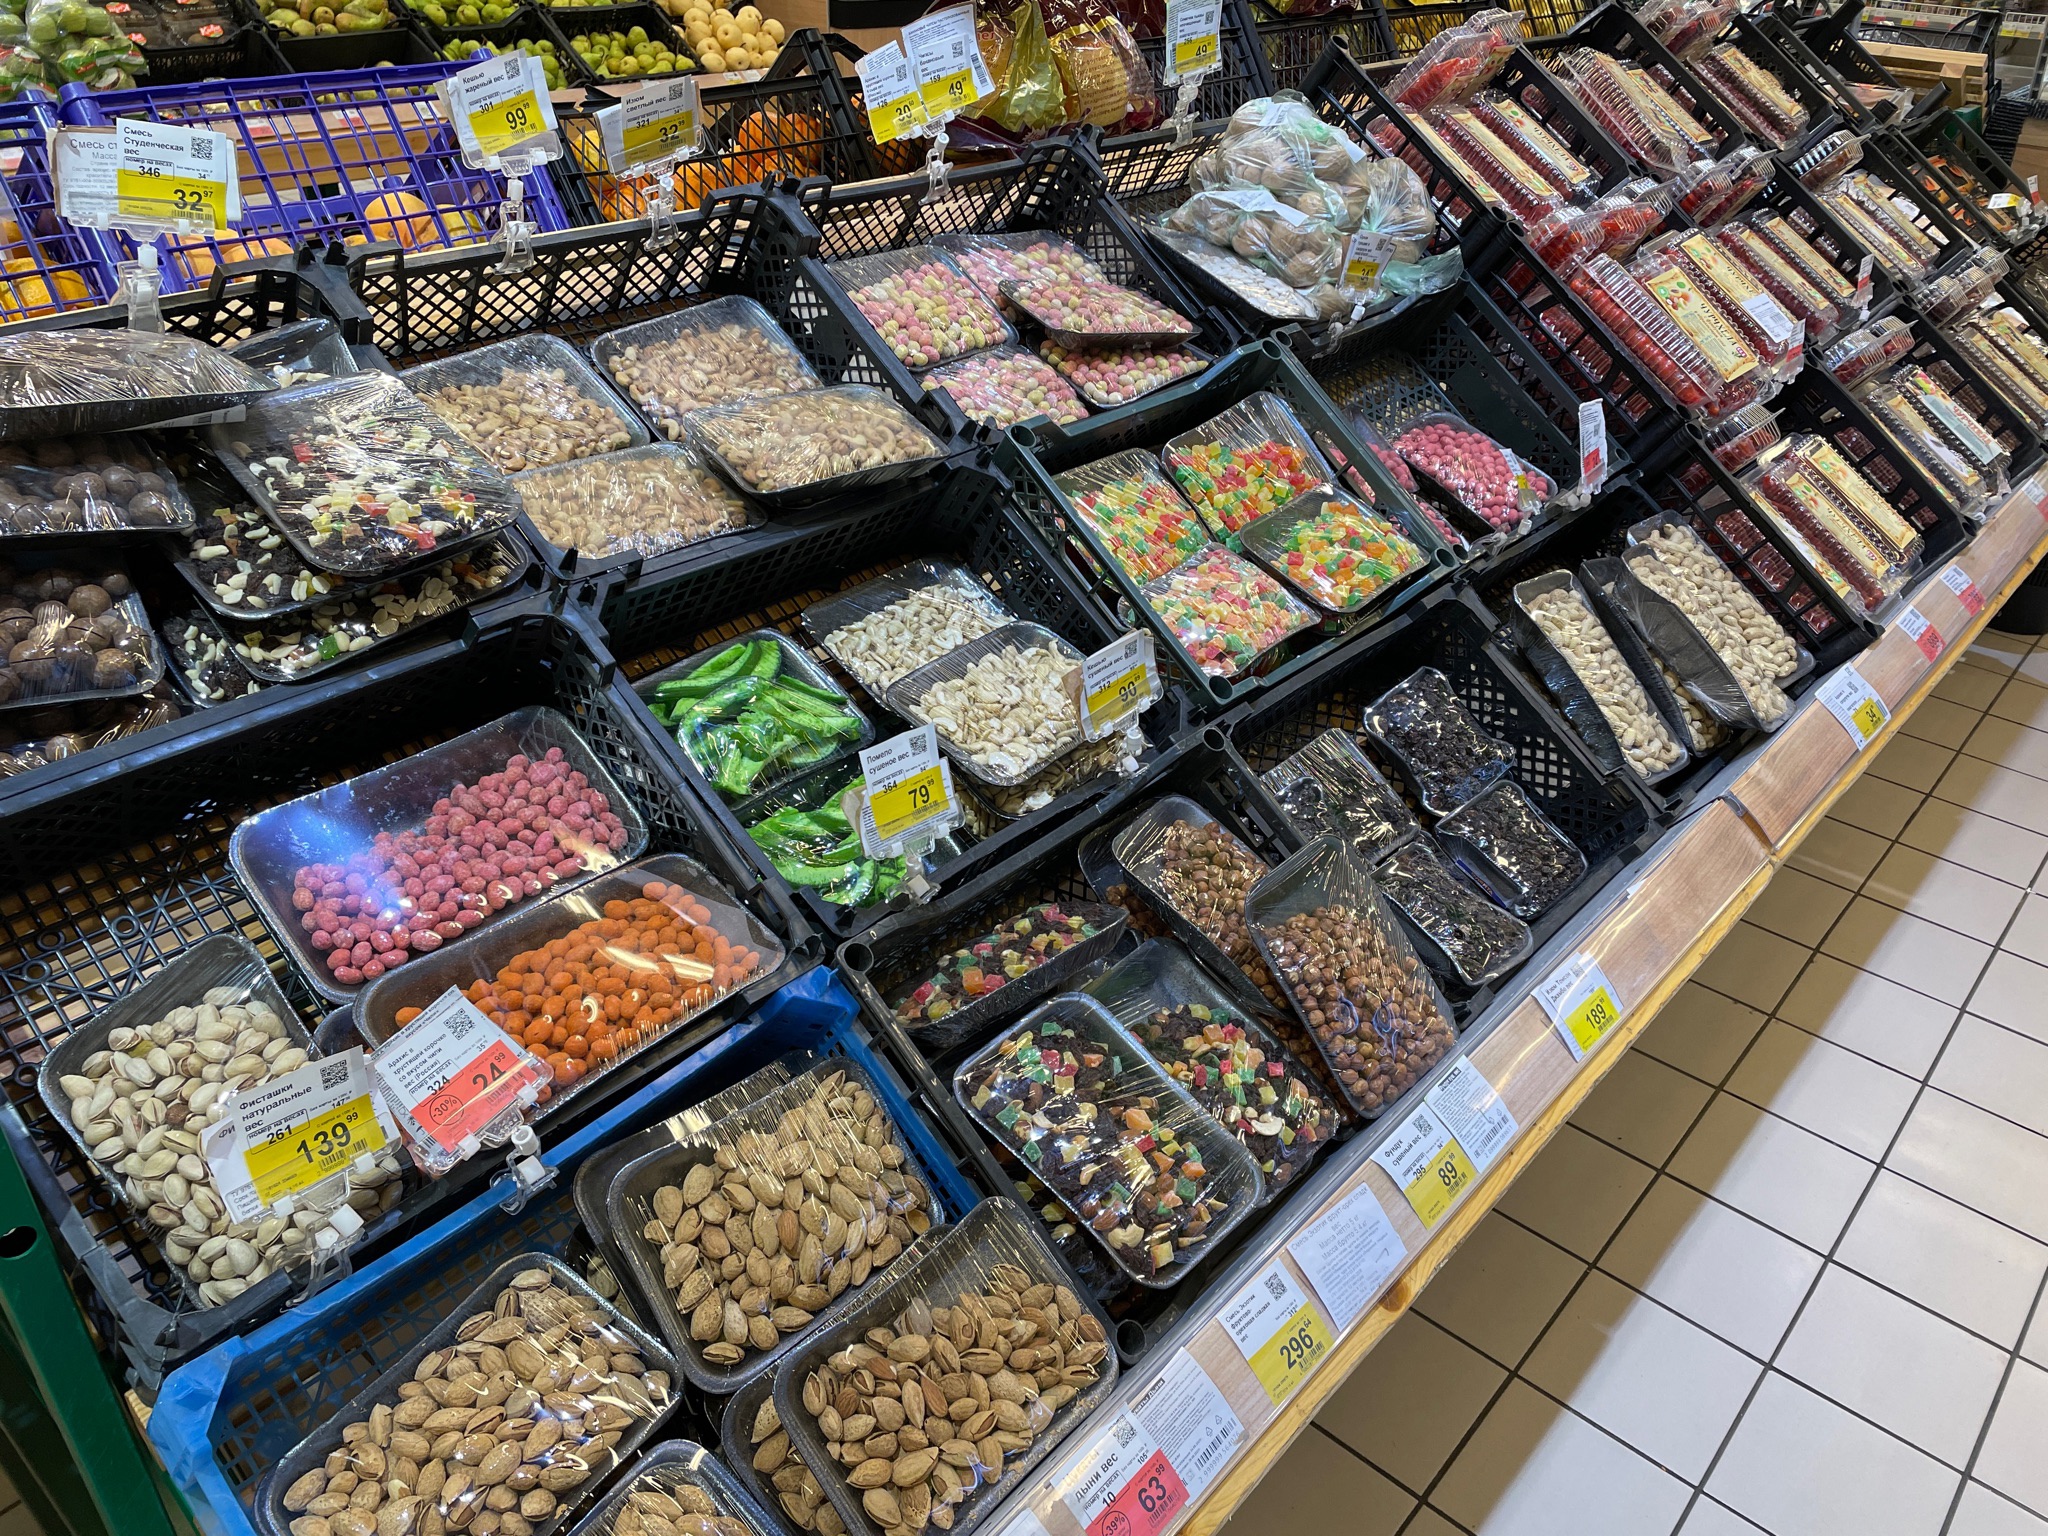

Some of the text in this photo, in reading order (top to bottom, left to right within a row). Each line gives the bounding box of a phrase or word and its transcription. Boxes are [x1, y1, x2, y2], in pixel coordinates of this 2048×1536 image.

[463, 72, 485, 84] Кешью
[465, 74, 505, 94] жареный вес
[948, 81, 963, 96] 49
[480, 101, 494, 114] 301
[626, 96, 645, 105] Изюм
[626, 96, 666, 113] светлый вес
[505, 102, 530, 130] 99 99
[896, 104, 912, 122] 30
[124, 126, 153, 138] Смесь
[636, 118, 650, 129] 321
[659, 124, 679, 143] 32
[70, 139, 105, 150] Смесь
[124, 136, 184, 152] Студенческая
[124, 148, 140, 156] вес
[138, 166, 161, 178] 346
[155, 160, 173, 168] весах
[173, 188, 213, 212] 32 97
[1726, 266, 1754, 294] ЧУРЧХЕ
[1700, 303, 1736, 348] ЧУРЧХЕЛА
[1087, 658, 1107, 671] Кешью
[1088, 656, 1123, 679] сушеный вес
[1098, 680, 1111, 694] 312
[1119, 681, 1137, 702] 90
[867, 748, 893, 764] Помело
[869, 750, 910, 775] сушеное вес
[882, 780, 898, 794] 364
[908, 778, 934, 809] 79 99
[1556, 972, 1571, 986] Томсон
[1551, 987, 1567, 1003] Джамбо
[1586, 1003, 1607, 1029] 189
[393, 1051, 424, 1076] хрустящей
[424, 1033, 447, 1054] корочке
[477, 1043, 486, 1052] 35
[388, 1053, 409, 1069] Арахис
[407, 1059, 427, 1077] вкусом
[428, 1047, 442, 1061] чили
[472, 1052, 506, 1090] 24 99
[404, 1059, 441, 1089] вес (Россия)
[411, 1080, 429, 1094] номер
[436, 1062, 451, 1076] весах
[427, 1074, 451, 1096] 324
[239, 1083, 294, 1111] Фисташки
[242, 1085, 312, 1122] натуральные
[331, 1098, 345, 1109] 147
[432, 1097, 458, 1119] -30%
[244, 1119, 264, 1133] вес
[250, 1126, 272, 1139] номер
[284, 1110, 305, 1125] весах
[267, 1124, 293, 1145] 261
[296, 1112, 359, 1164] 139 99
[1384, 1139, 1403, 1158] Фундук
[1392, 1135, 1422, 1167] сушеный вес
[1412, 1164, 1427, 1181] 295
[1438, 1152, 1458, 1187] 89 99
[1291, 1233, 1309, 1250] Смесь
[1309, 1219, 1329, 1239] Экзотик
[1331, 1221, 1342, 1231] вес
[1318, 1234, 1336, 1249] Масса
[1335, 1224, 1350, 1239] нетто
[1322, 1246, 1337, 1260] Масса
[1337, 1232, 1354, 1247] брутто
[1225, 1294, 1256, 1323] Смесь Экзотик
[1235, 1301, 1271, 1336] ореховая сладкая
[1288, 1308, 1297, 1318] 312
[1230, 1308, 1252, 1330] фруктово-
[1240, 1333, 1249, 1343] вес
[1280, 1318, 1314, 1370] 296 64
[1149, 1378, 1164, 1397] Дыни
[1137, 1453, 1148, 1465] 105
[1204, 1456, 1222, 1476] 999999
[1075, 1453, 1119, 1502] дыни вес
[1084, 1494, 1100, 1511] номер
[1106, 1473, 1120, 1488] весах
[1138, 1464, 1167, 1512] 63 99
[1102, 1491, 1116, 1508] 10
